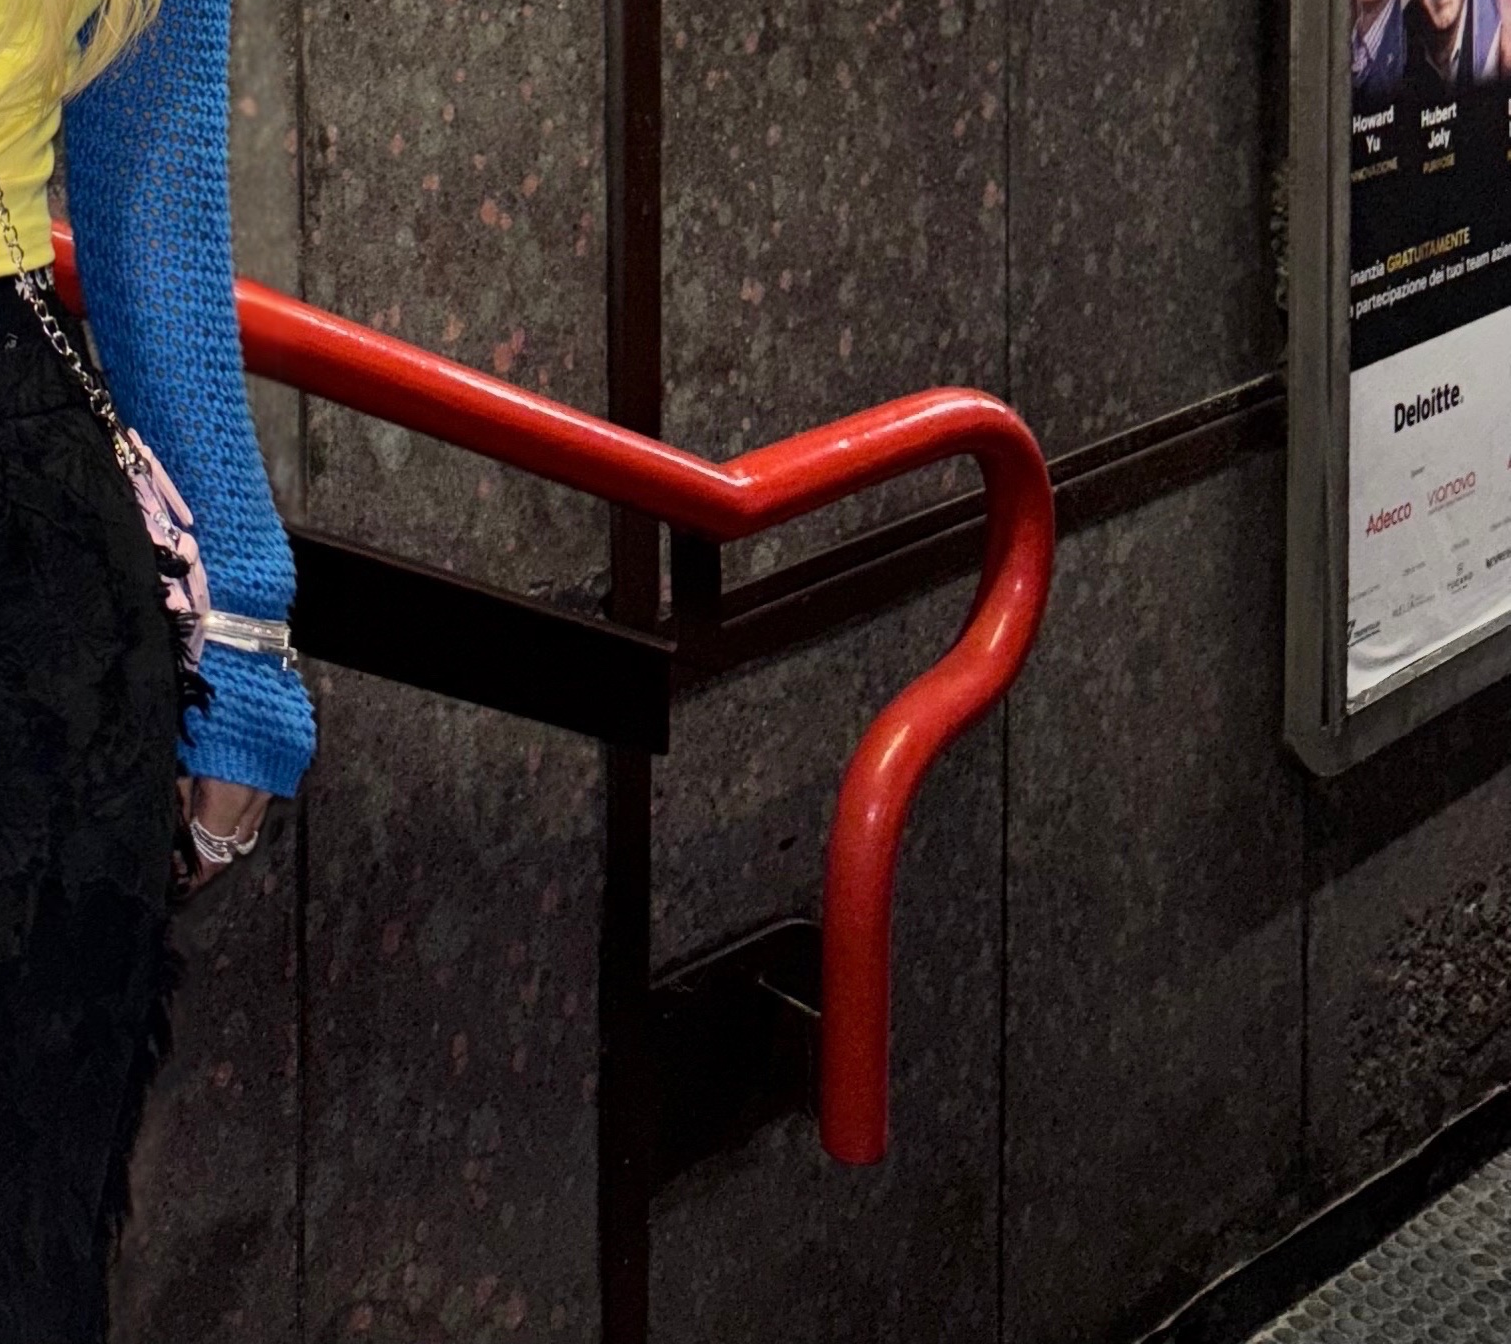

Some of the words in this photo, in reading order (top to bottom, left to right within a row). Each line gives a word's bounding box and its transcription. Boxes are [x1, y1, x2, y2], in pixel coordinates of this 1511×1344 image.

[1352, 105, 1395, 134] Howard
[1420, 102, 1458, 128] Hubert
[1366, 134, 1381, 154] Yu
[1427, 127, 1451, 150] Joly
[1386, 226, 1471, 273] GRATUITAMENTE
[1355, 278, 1428, 320] partecipazione
[1428, 264, 1445, 287] dei
[1365, 502, 1412, 538] Adecco
